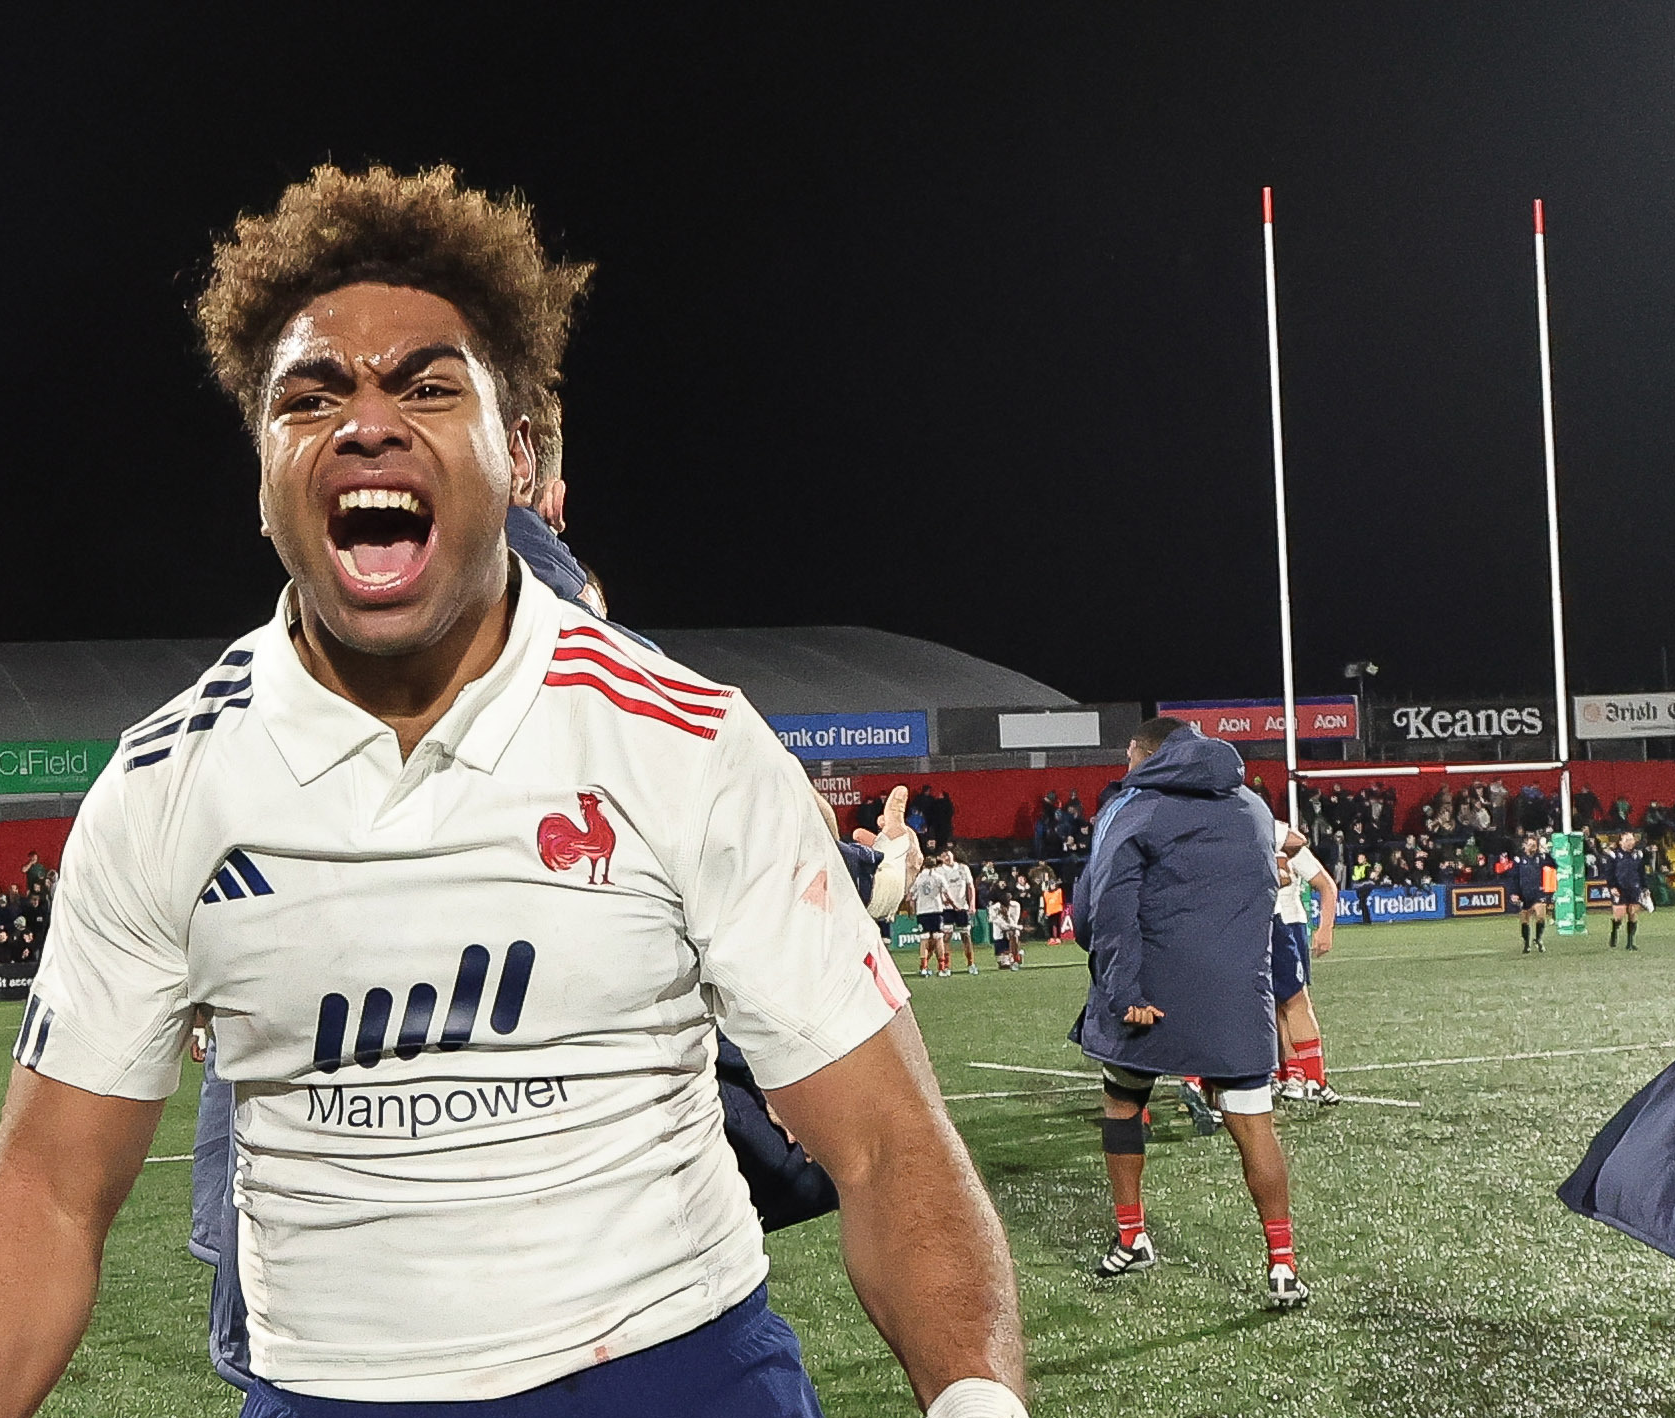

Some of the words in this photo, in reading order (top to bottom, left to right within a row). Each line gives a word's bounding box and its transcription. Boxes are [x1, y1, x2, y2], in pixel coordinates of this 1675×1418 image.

[1313, 713, 1347, 730] AON
[1605, 701, 1658, 722] Irish
[1218, 716, 1251, 733] AON
[1264, 713, 1298, 732] AO
[1393, 706, 1543, 739] Keanes
[775, 727, 813, 747] ank
[815, 726, 838, 747] of
[840, 725, 911, 746] Ireland
[813, 777, 852, 793] NORTH
[1373, 892, 1436, 914] Ireland
[1470, 893, 1499, 908] ALDI
[307, 1076, 568, 1137] Manpower
